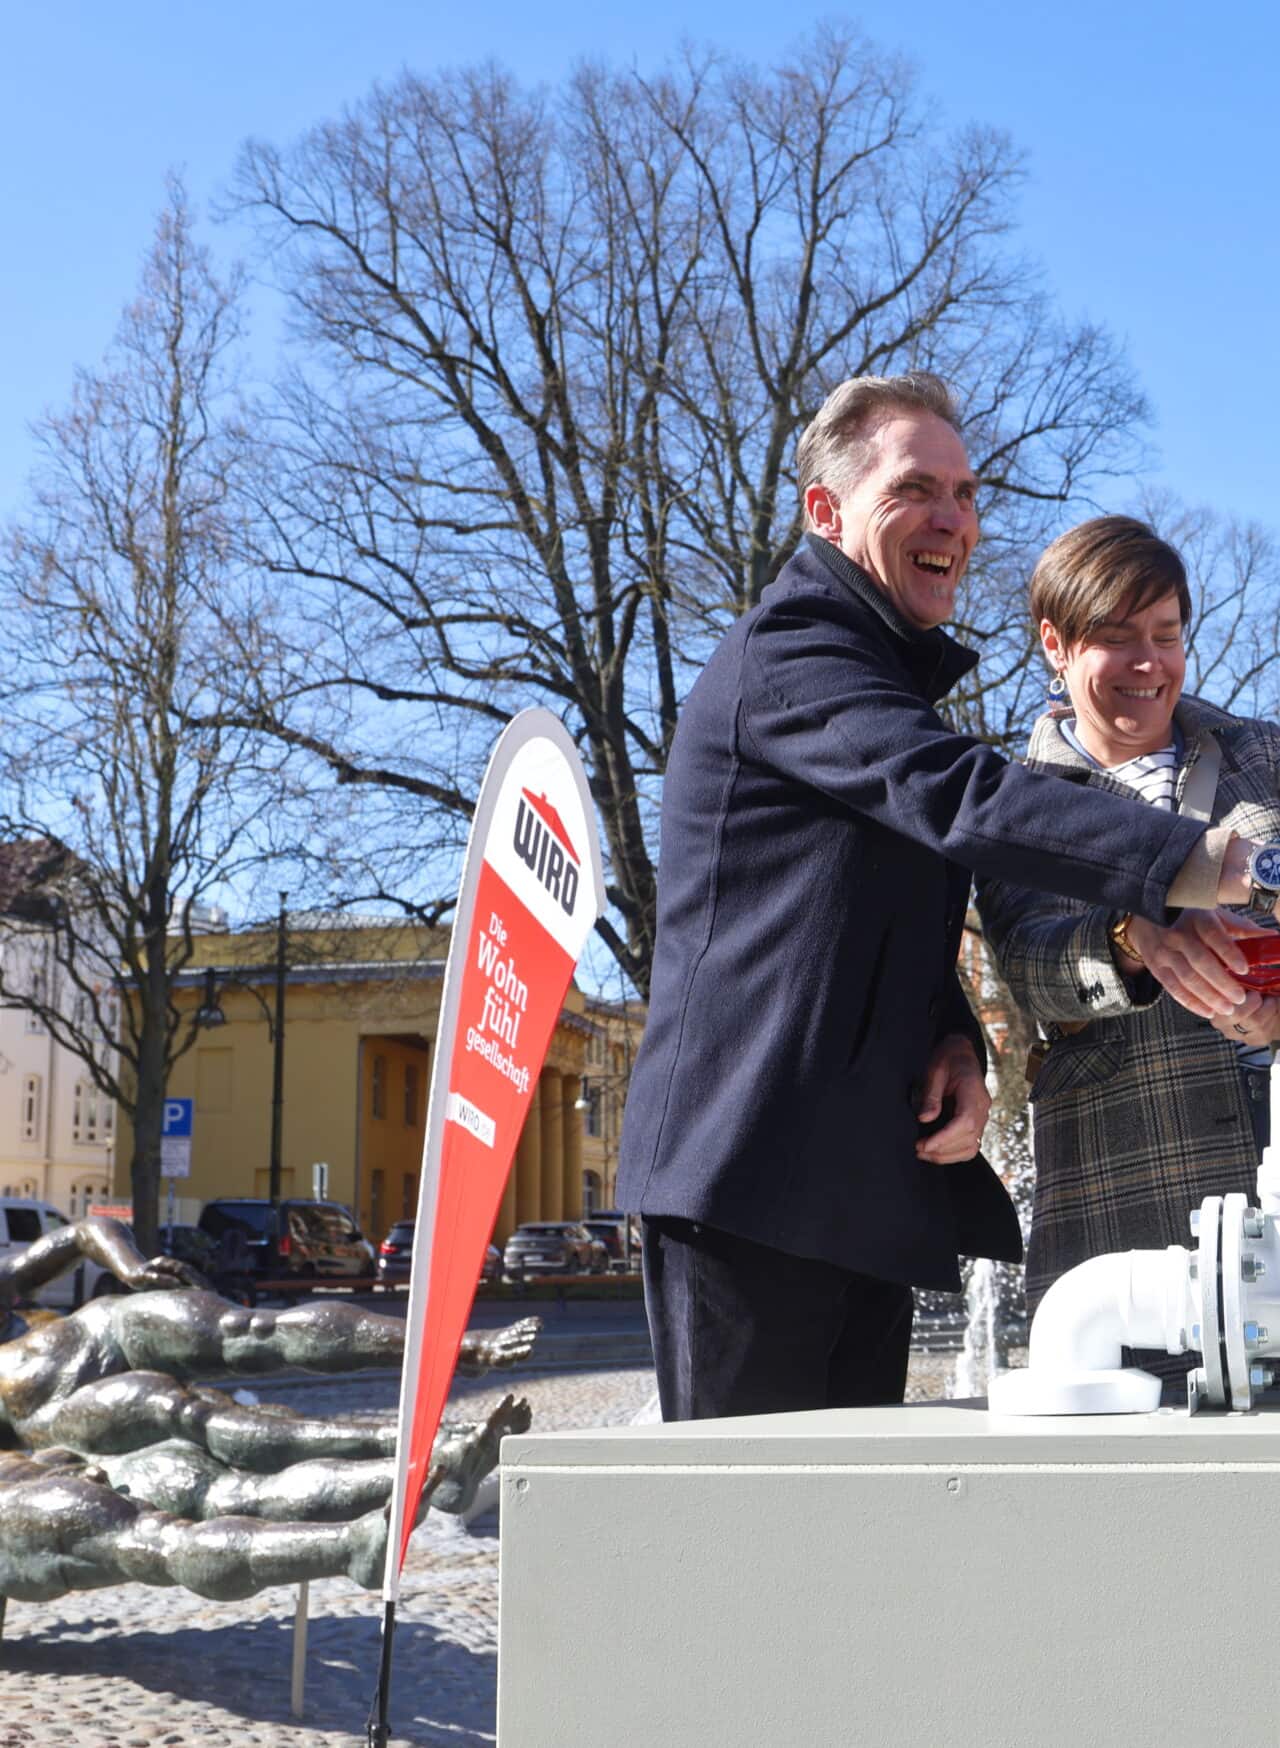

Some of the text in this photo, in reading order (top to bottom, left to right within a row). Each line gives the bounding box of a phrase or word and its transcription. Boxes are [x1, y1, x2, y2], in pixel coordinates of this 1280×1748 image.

[513, 797, 580, 917] WIRO
[488, 911, 508, 947] Die
[477, 930, 528, 1012] Wohn
[477, 986, 521, 1049] fühl
[465, 1026, 531, 1094] gesellschaft
[163, 1103, 185, 1133] P
